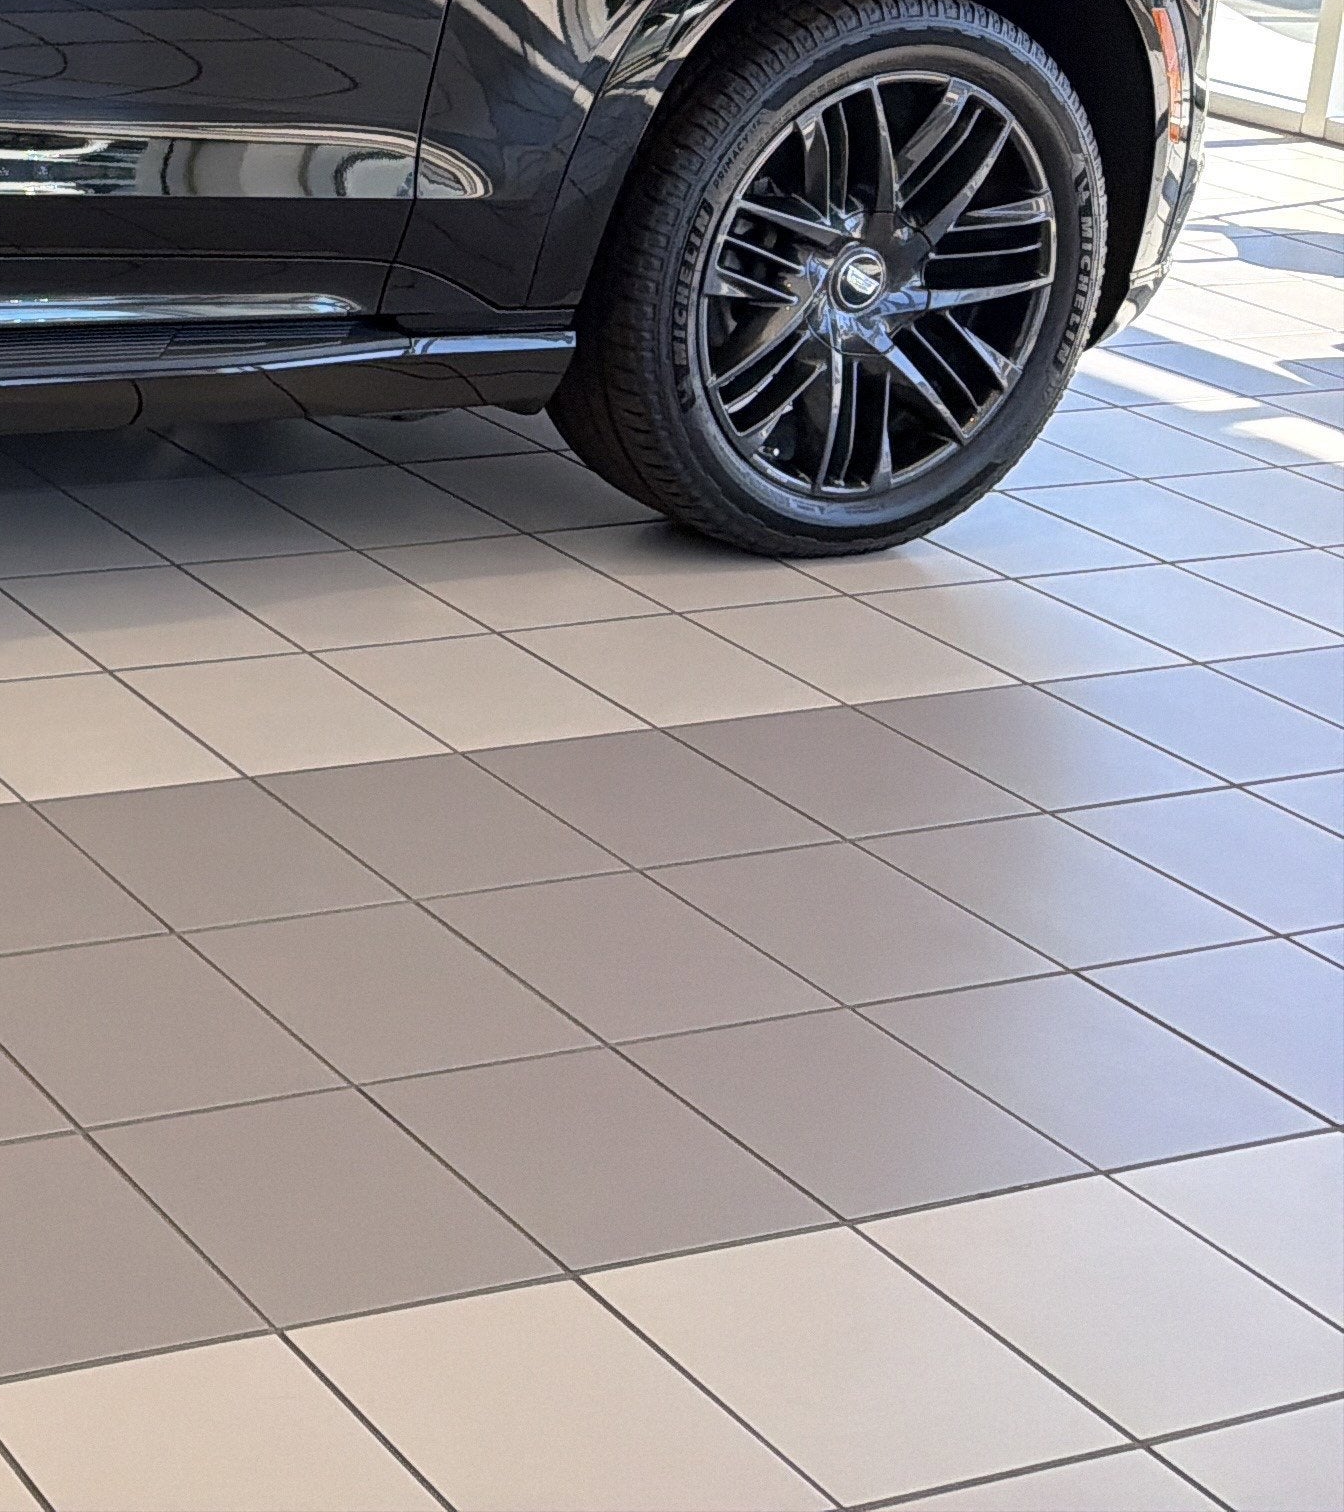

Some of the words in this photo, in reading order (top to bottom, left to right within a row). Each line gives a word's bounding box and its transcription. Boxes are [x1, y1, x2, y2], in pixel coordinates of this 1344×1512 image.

[713, 135, 751, 189] PRIMACY
[672, 199, 714, 367] MICHELIN
[1056, 215, 1093, 365] MICHELIN
